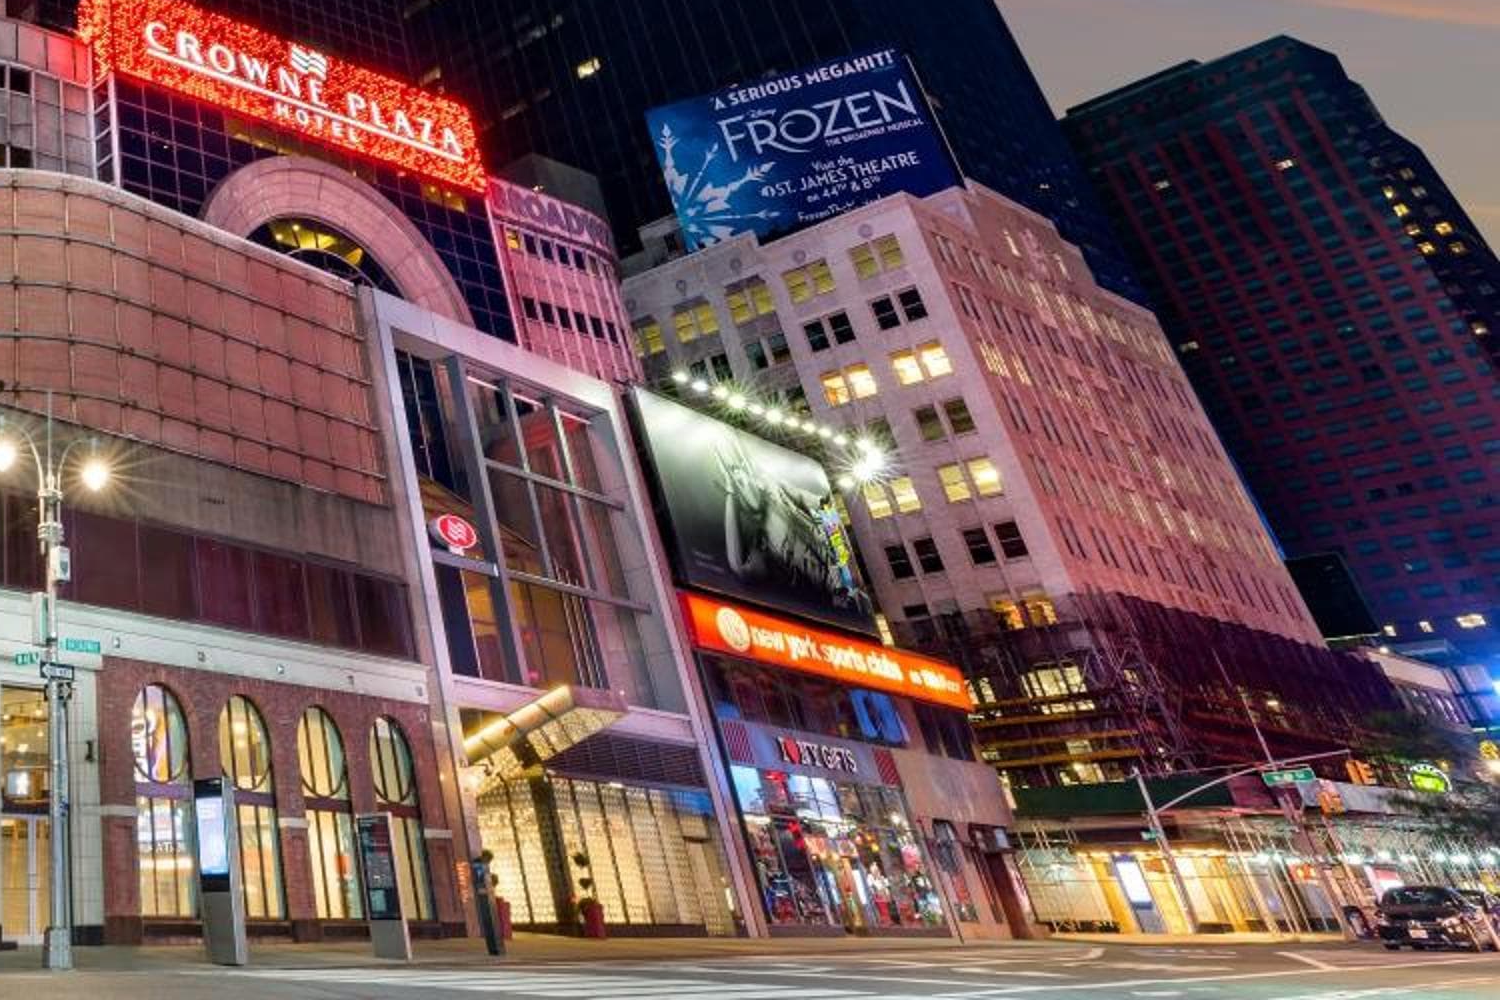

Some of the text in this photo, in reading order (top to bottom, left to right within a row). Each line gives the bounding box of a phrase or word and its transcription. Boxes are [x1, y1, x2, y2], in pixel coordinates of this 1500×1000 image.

[144, 20, 464, 158] CROWNE PLAZA
[727, 75, 803, 106] SERIOUS
[275, 101, 359, 144] HOTEL
[716, 79, 918, 163] FROZEN
[775, 151, 921, 197] ST. JAMES THEATRE
[751, 626, 785, 652] new
[785, 631, 821, 661] york
[819, 642, 868, 671] sports
[796, 740, 823, 767] NY
[820, 744, 858, 773] GIFTS
